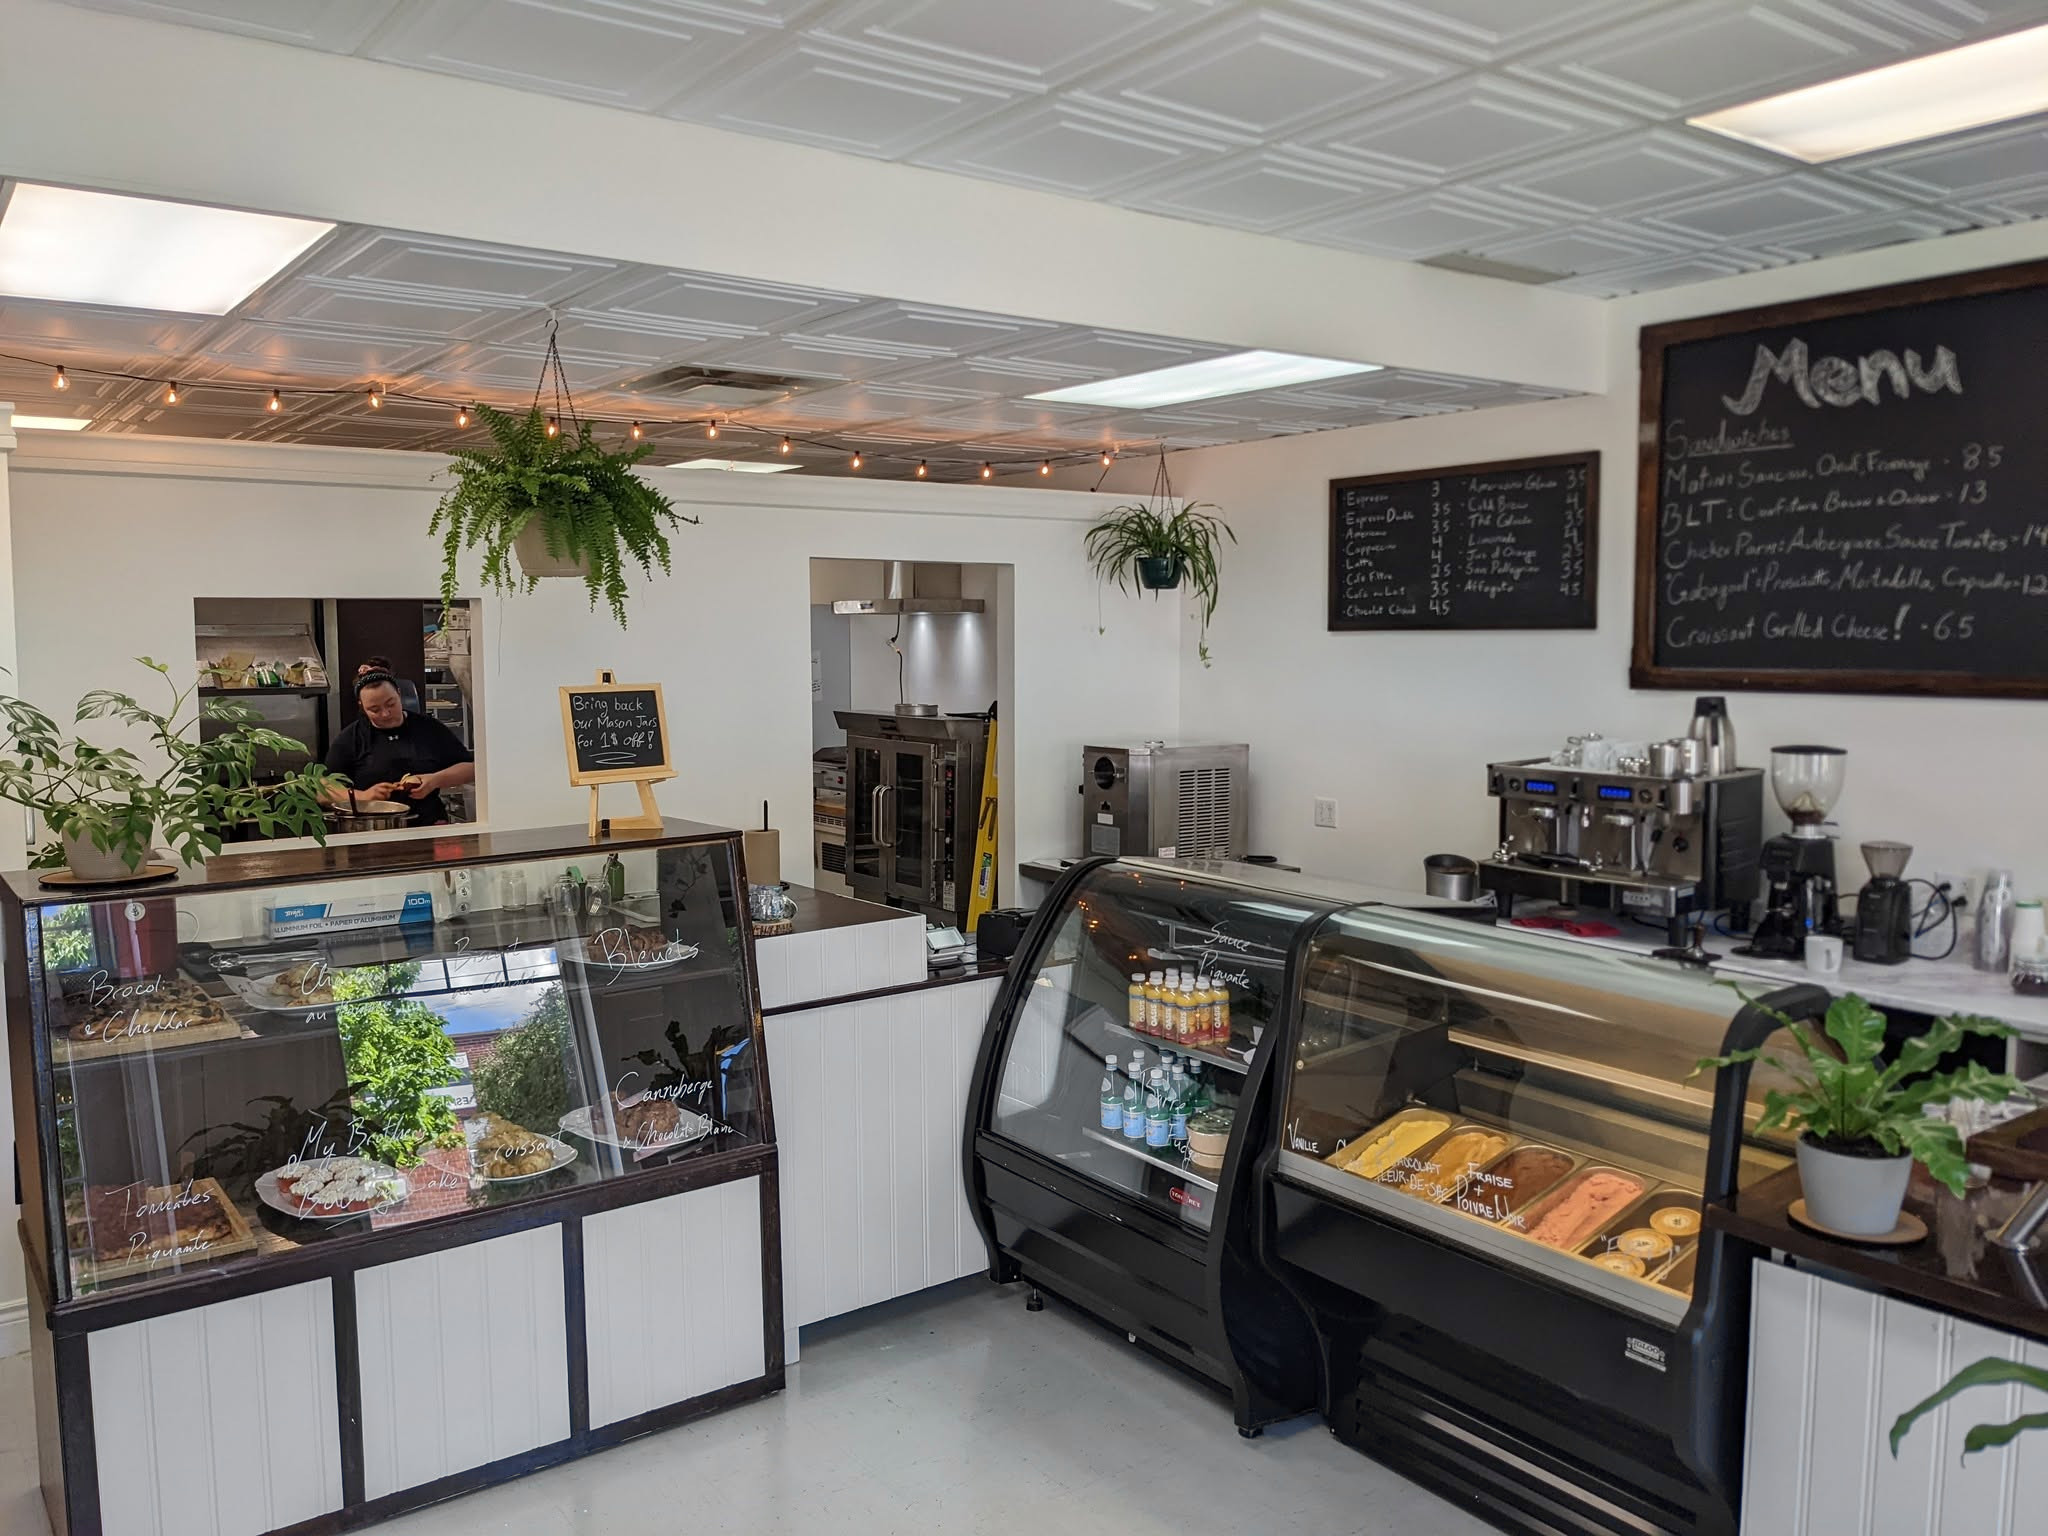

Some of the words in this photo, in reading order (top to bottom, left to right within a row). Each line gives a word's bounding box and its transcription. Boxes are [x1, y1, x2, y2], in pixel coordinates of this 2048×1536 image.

[1721, 337, 1963, 415] Menu
[1432, 481, 1439, 497] 3
[1566, 491, 1579, 510] 4
[1960, 480, 1987, 504] 13
[1432, 535, 1443, 548] 4
[1564, 528, 1578, 543] 4
[1431, 550, 1442, 563] 4
[1666, 616, 1754, 648] Croissant
[1763, 611, 1823, 640] Grilled
[573, 696, 608, 718] Bring
[615, 697, 643, 711] back
[573, 718, 592, 729] our
[597, 716, 633, 729] Mason
[635, 715, 657, 728] Jars
[577, 734, 592, 749] for
[600, 731, 618, 748] 1$
[309, 922, 324, 931] FOIL
[330, 918, 353, 927] PAPIER
[354, 914, 396, 925] D'ALUMINIUM
[1204, 920, 1250, 952] Sauce
[594, 927, 699, 986] Bleuets
[1199, 950, 1250, 989] Piquante
[88, 970, 166, 1007] Brocoli
[103, 1009, 193, 1042] Cheddar
[1150, 1002, 1158, 1027] OASIS
[615, 1071, 713, 1108] Canneberge
[635, 1119, 690, 1151] Chocolat
[696, 1113, 733, 1142] Blanc
[1467, 1162, 1514, 1188] FRAISE
[105, 1178, 214, 1231] Tomates
[1455, 1174, 1495, 1219] POIVRE
[1495, 1194, 1526, 1230] NOIR
[129, 1230, 214, 1269] Piquante
